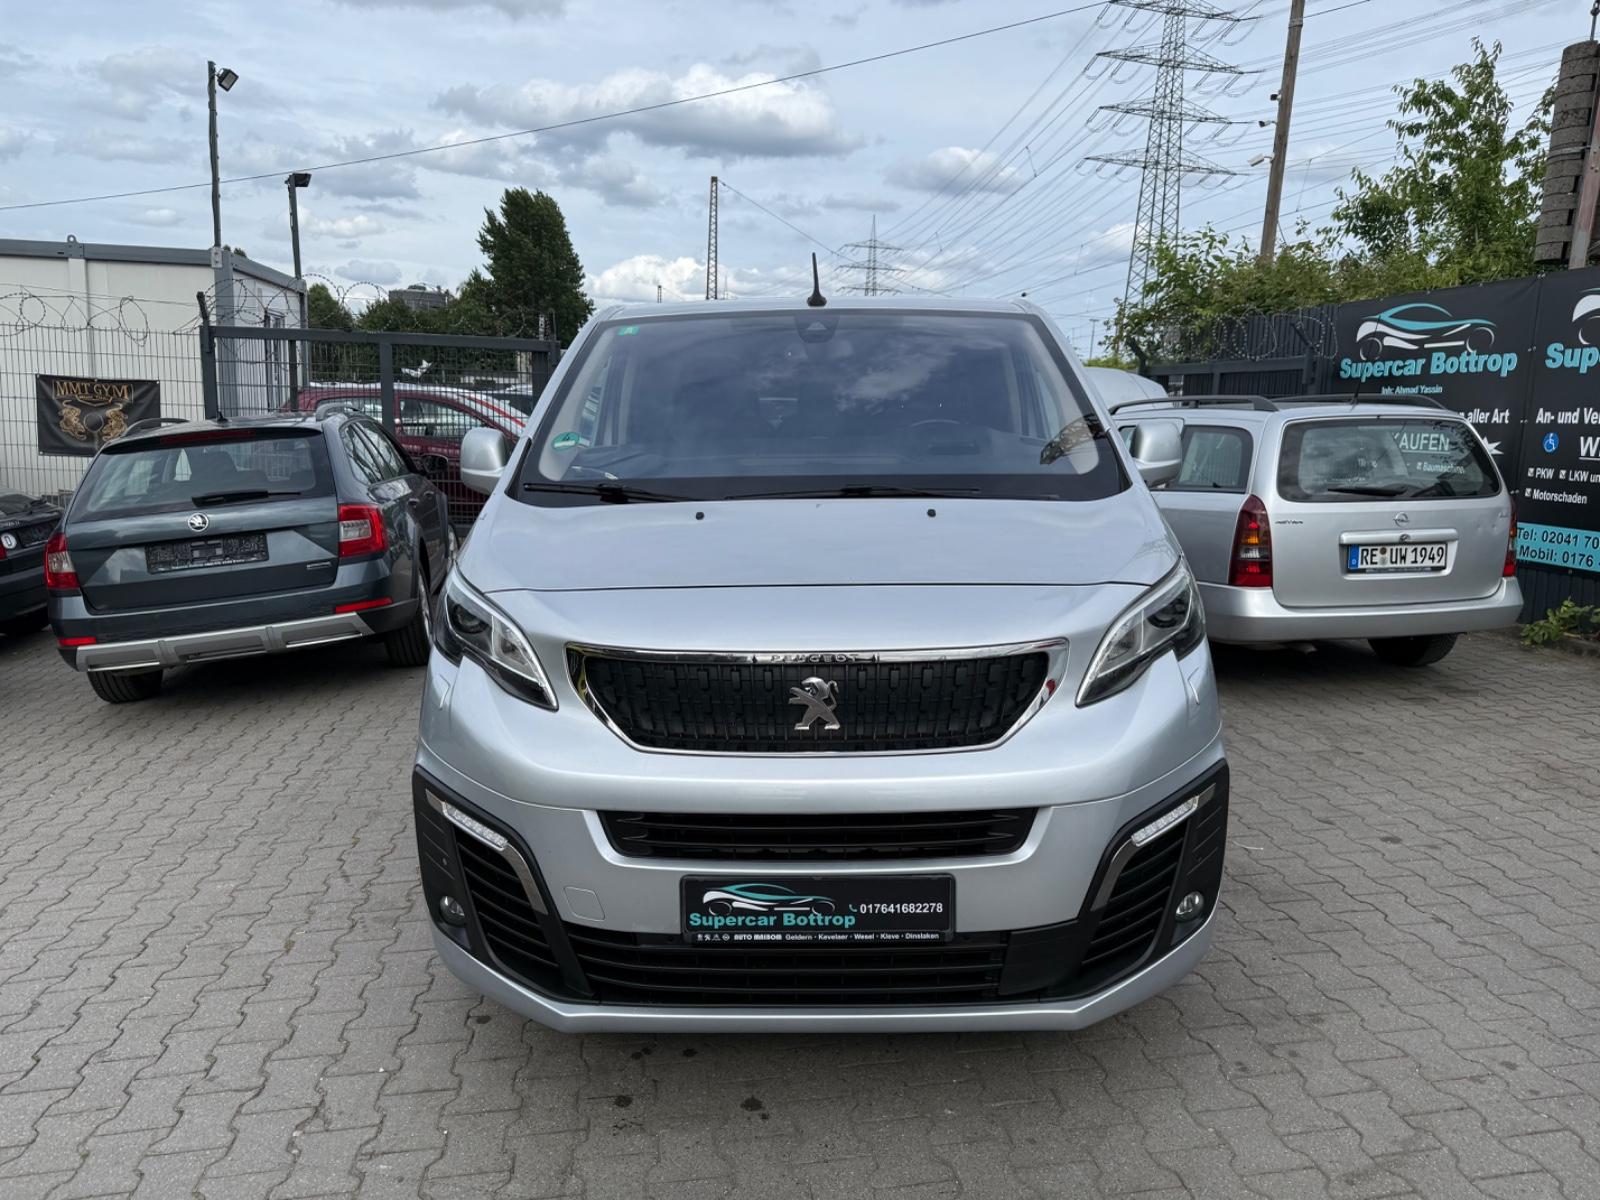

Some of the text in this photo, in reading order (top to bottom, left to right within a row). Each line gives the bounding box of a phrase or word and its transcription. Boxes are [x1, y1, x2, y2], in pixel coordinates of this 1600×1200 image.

[1340, 350, 1518, 383] Supercar Bottrop
[1545, 342, 1600, 374] Sup
[55, 380, 129, 400] MMT GYM
[1467, 408, 1510, 424] aller Art
[1536, 407, 1555, 424] An-
[1557, 407, 1580, 424] und
[1580, 436, 1600, 457] W
[1535, 467, 1554, 479] PKW
[1568, 469, 1588, 482] LKW
[1532, 488, 1588, 505] Motorschaden
[1517, 527, 1537, 541] Tel:
[1541, 530, 1579, 547] 02041
[1360, 546, 1445, 566] RE UW 1949
[1520, 545, 1594, 567] Mobil: 0176
[860, 902, 943, 914] 017641682278
[689, 912, 856, 929] Supercar Bottrop
